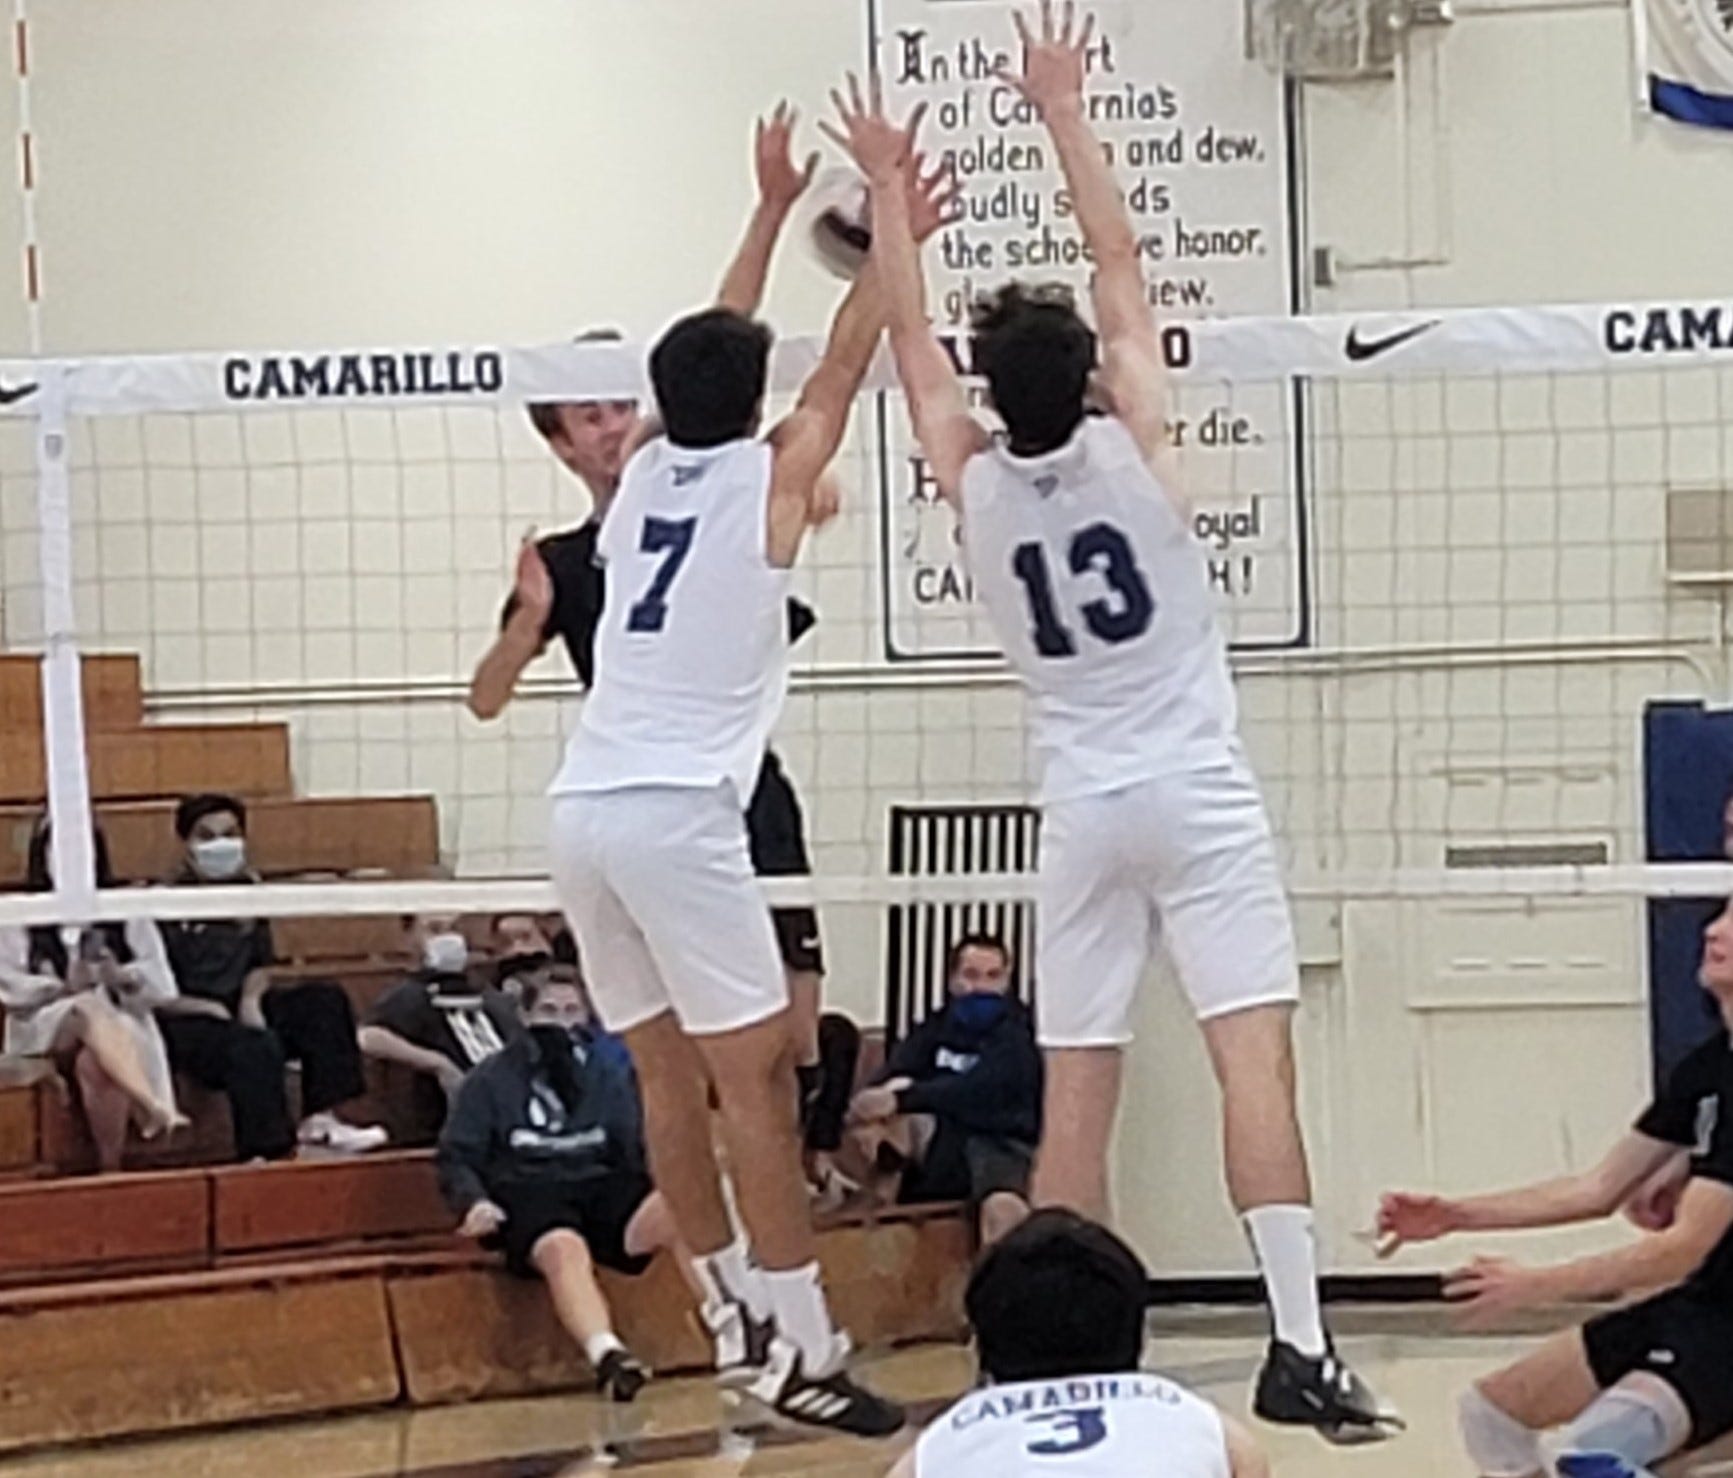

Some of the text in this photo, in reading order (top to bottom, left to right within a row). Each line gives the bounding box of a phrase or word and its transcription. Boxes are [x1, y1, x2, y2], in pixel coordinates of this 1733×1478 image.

[896, 30, 949, 84] In
[958, 37, 1009, 80] the
[939, 87, 972, 129] of
[942, 134, 1044, 187] golden
[1126, 127, 1183, 167] and
[1195, 125, 1265, 164] dew.
[942, 229, 993, 269] the
[1174, 217, 1267, 259] honor.
[1604, 307, 1733, 353] CAM
[224, 351, 503, 400] CAMARILLO
[1198, 407, 1265, 447] die.
[1192, 493, 1260, 551] oyal
[625, 516, 699, 633] 7
[1012, 521, 1154, 658] 13
[1023, 1404, 1107, 1455] 3
